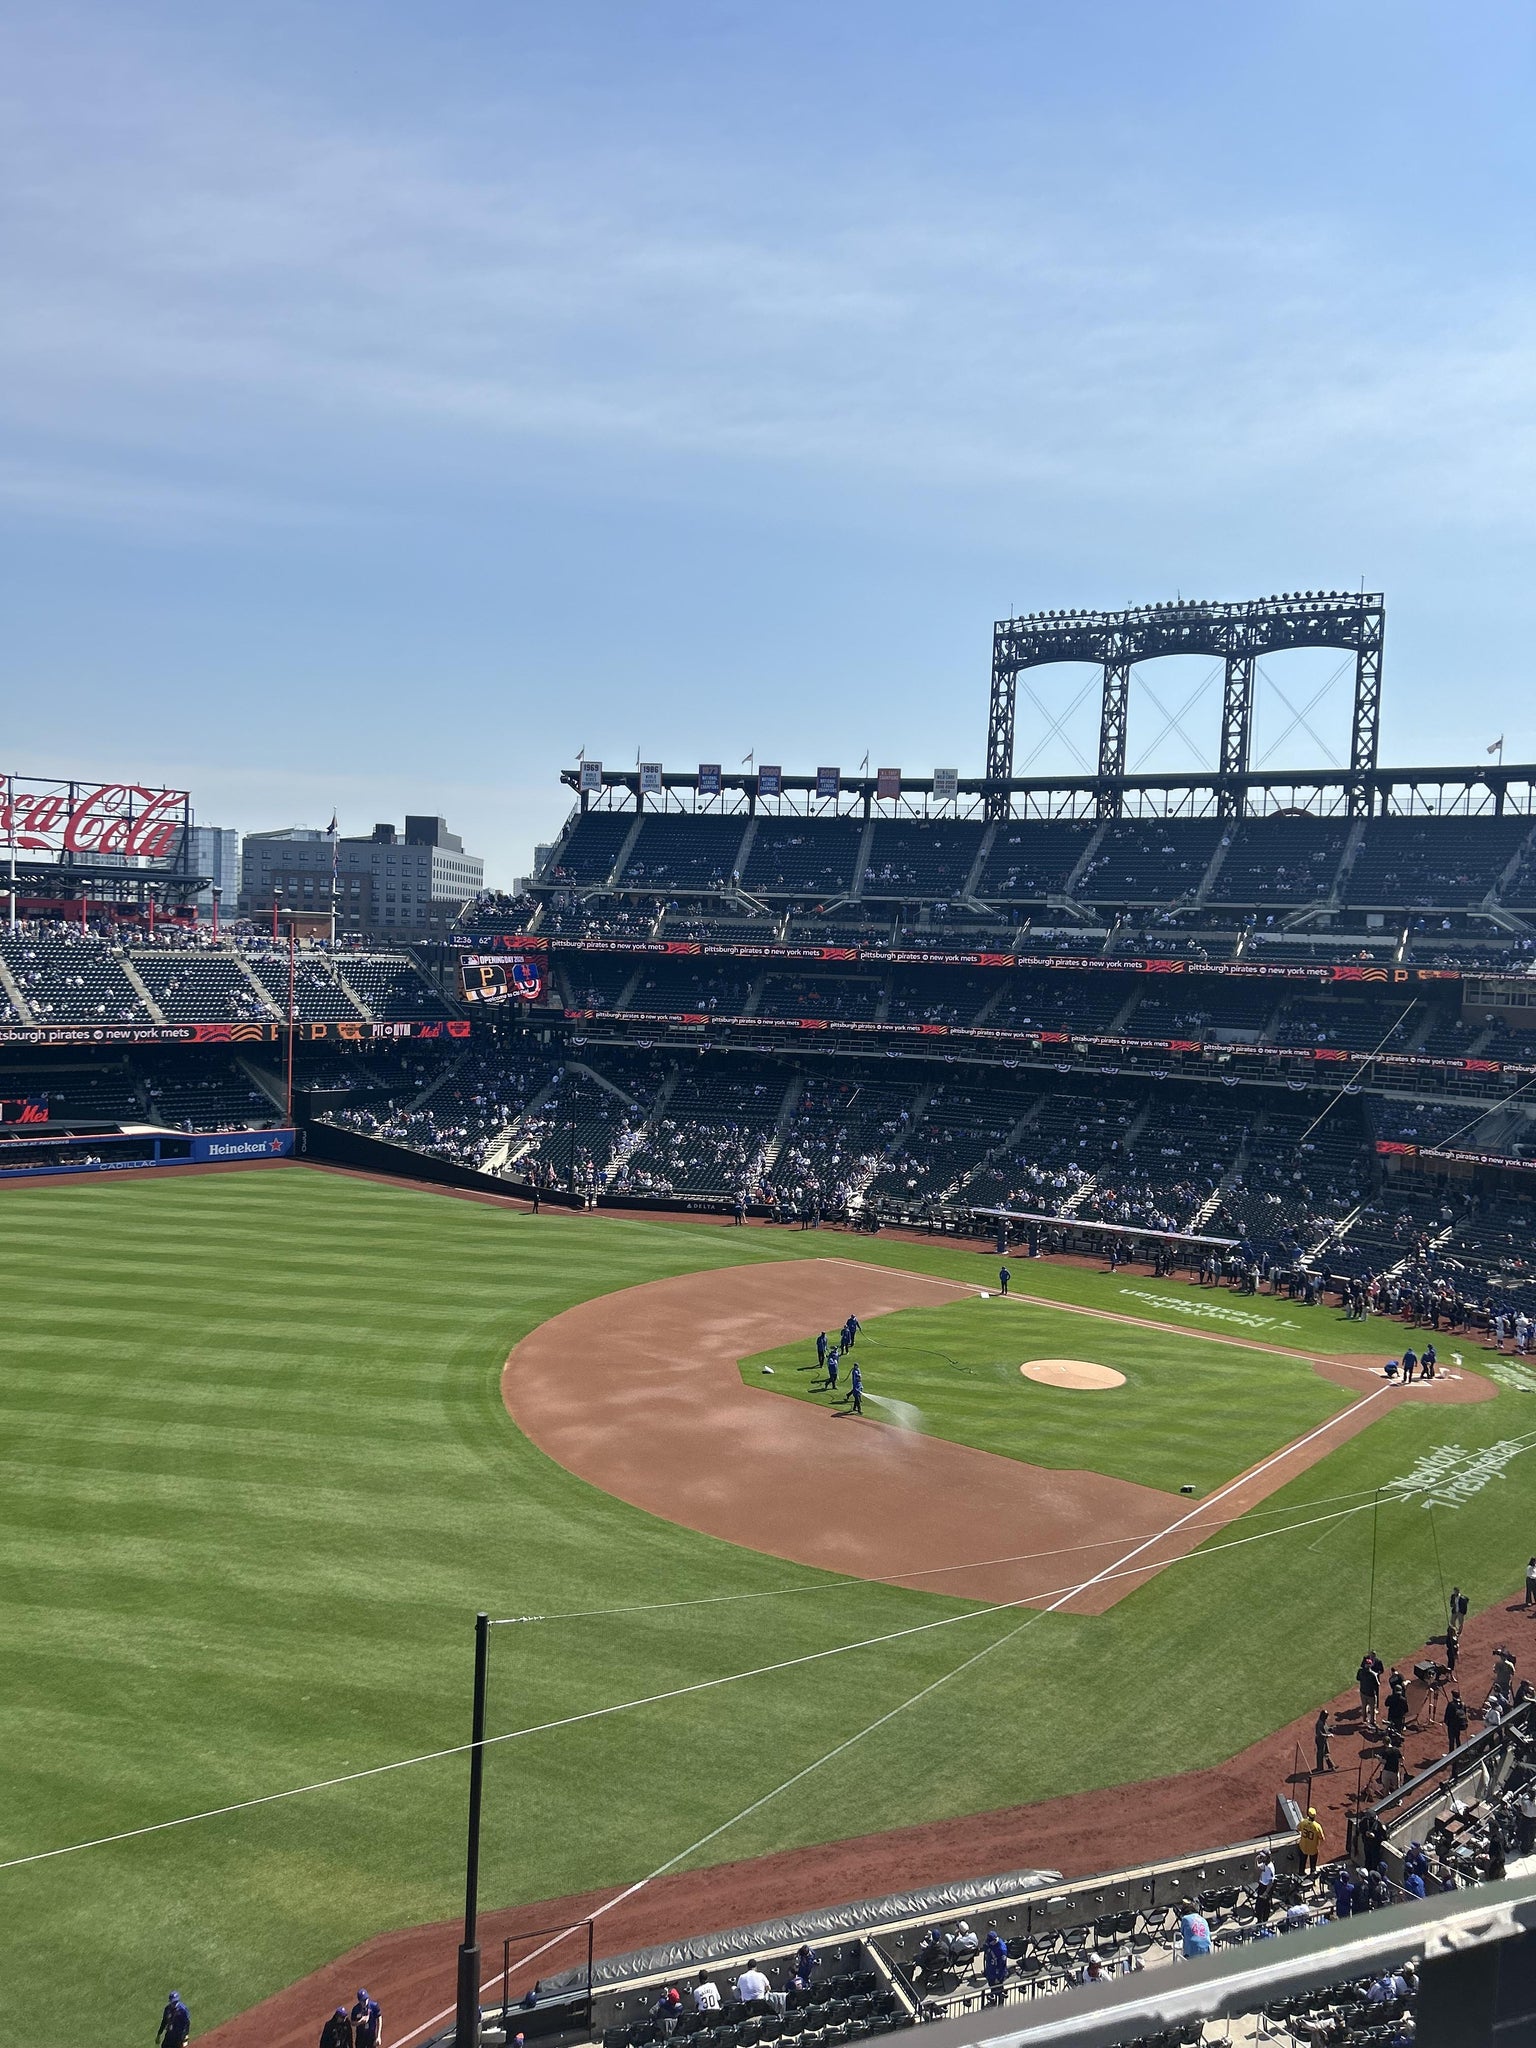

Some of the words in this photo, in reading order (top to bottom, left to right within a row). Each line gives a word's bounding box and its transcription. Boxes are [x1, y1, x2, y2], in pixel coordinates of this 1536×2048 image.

[584, 764, 599, 772] 1969
[552, 940, 585, 950] pittsburgh
[586, 941, 608, 950] pirates
[704, 946, 738, 955] pittsburgh
[480, 956, 504, 964] OPENING
[860, 952, 896, 960] pittsburgh
[897, 952, 920, 960] pirates
[1018, 957, 1054, 967] pittsburgh
[1056, 958, 1080, 966] pirates
[1106, 960, 1122, 968] york
[1189, 964, 1228, 974] pittsburgh
[1230, 965, 1257, 974] pirates
[1287, 967, 1304, 975] york
[49, 1030, 90, 1042] pirates
[106, 1030, 131, 1038] new
[133, 1028, 158, 1040] york
[161, 1029, 189, 1037] mets
[373, 1024, 384, 1036] PIT
[209, 1142, 266, 1155] Heineken
[1420, 1150, 1454, 1158] pittsburgh
[100, 1160, 156, 1170] CADILLAC
[1302, 1828, 1314, 1840] 30
[702, 1995, 715, 2009] 30
